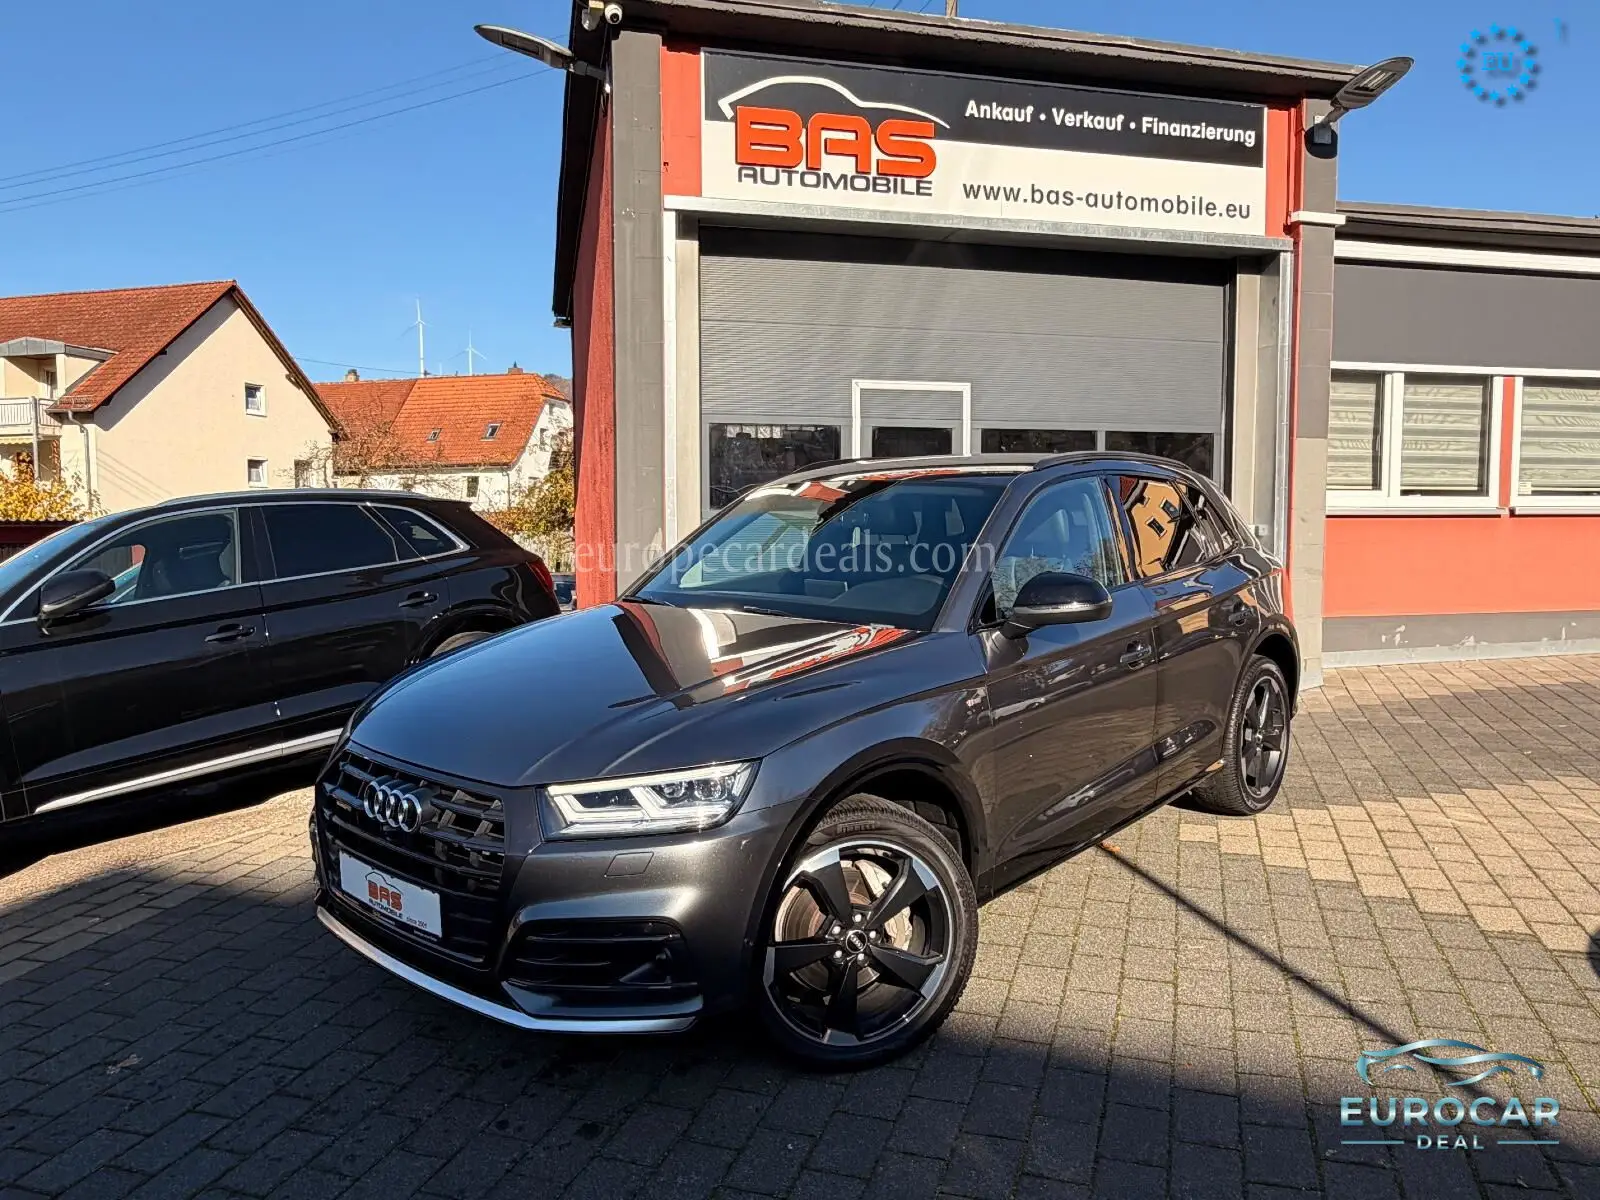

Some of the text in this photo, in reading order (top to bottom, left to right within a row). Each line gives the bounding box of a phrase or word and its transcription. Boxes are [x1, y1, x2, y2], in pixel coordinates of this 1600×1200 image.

[735, 105, 937, 178] BAS
[965, 100, 1256, 148] Ankauf Verkauf Finanzierung
[737, 166, 933, 197] AUTOMOBILE
[962, 182, 1251, 220] www.bas-automobile.eu
